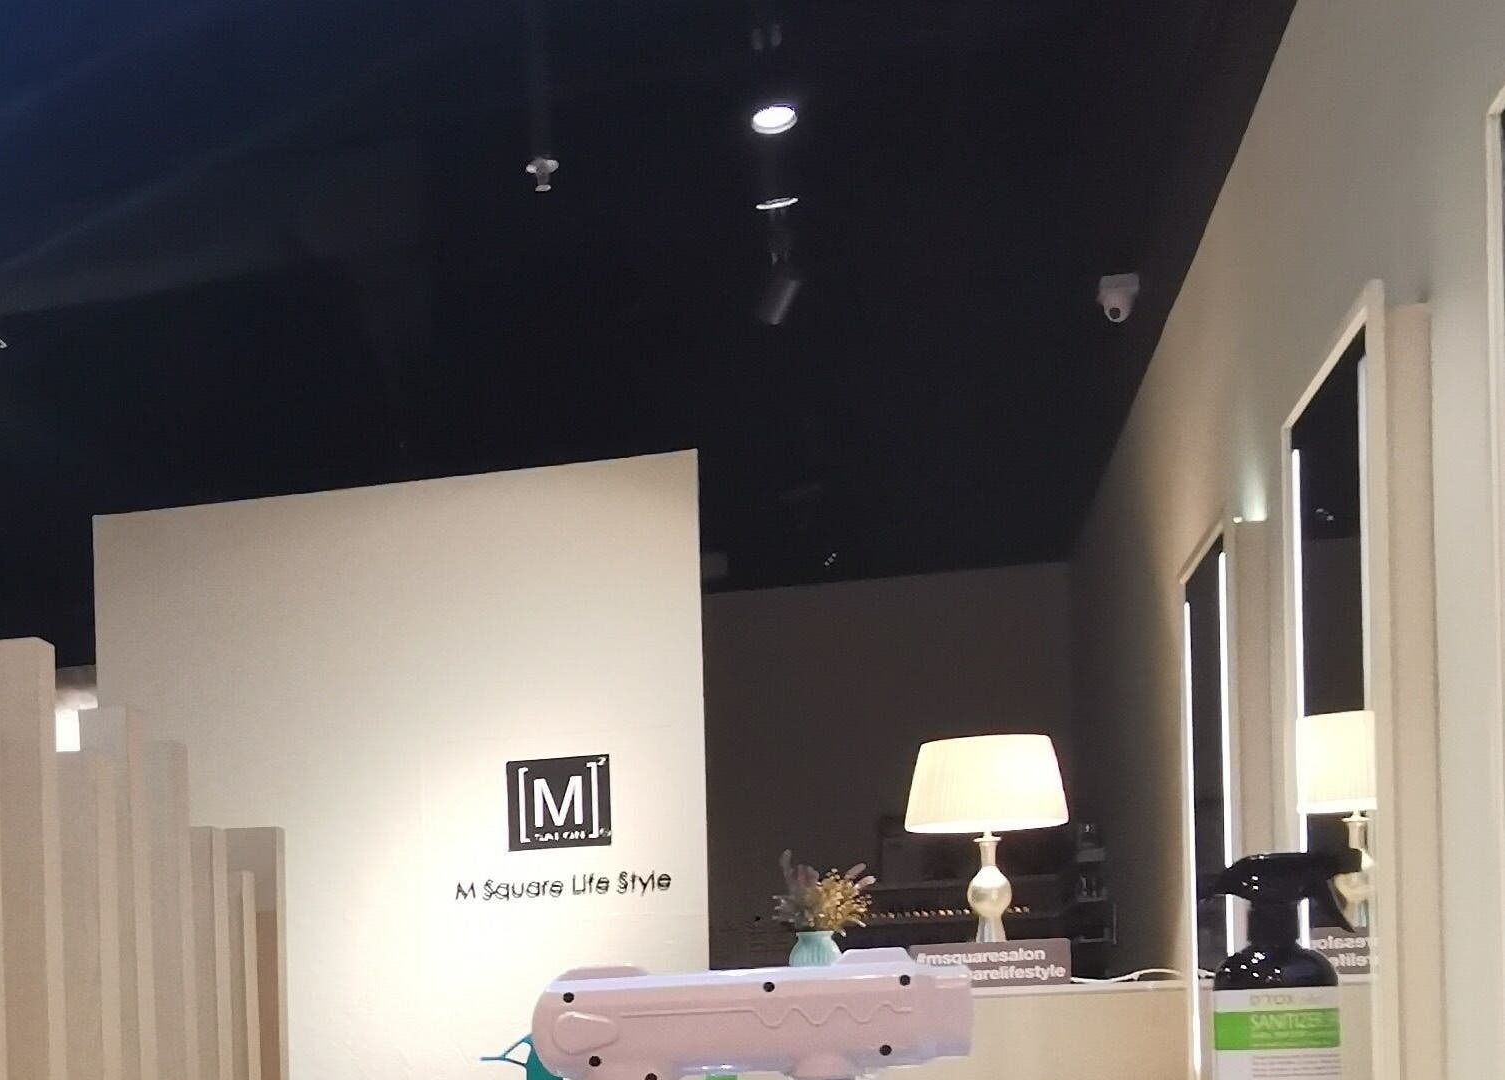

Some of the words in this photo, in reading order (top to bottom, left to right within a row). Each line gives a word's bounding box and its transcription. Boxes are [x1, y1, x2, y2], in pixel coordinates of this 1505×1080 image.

[456, 882, 476, 900] M
[483, 879, 564, 901] Square
[572, 873, 610, 895] Life
[617, 870, 671, 897] Style
[917, 948, 1045, 965] #msquaresalon
[970, 964, 1066, 980] arelifestyle
